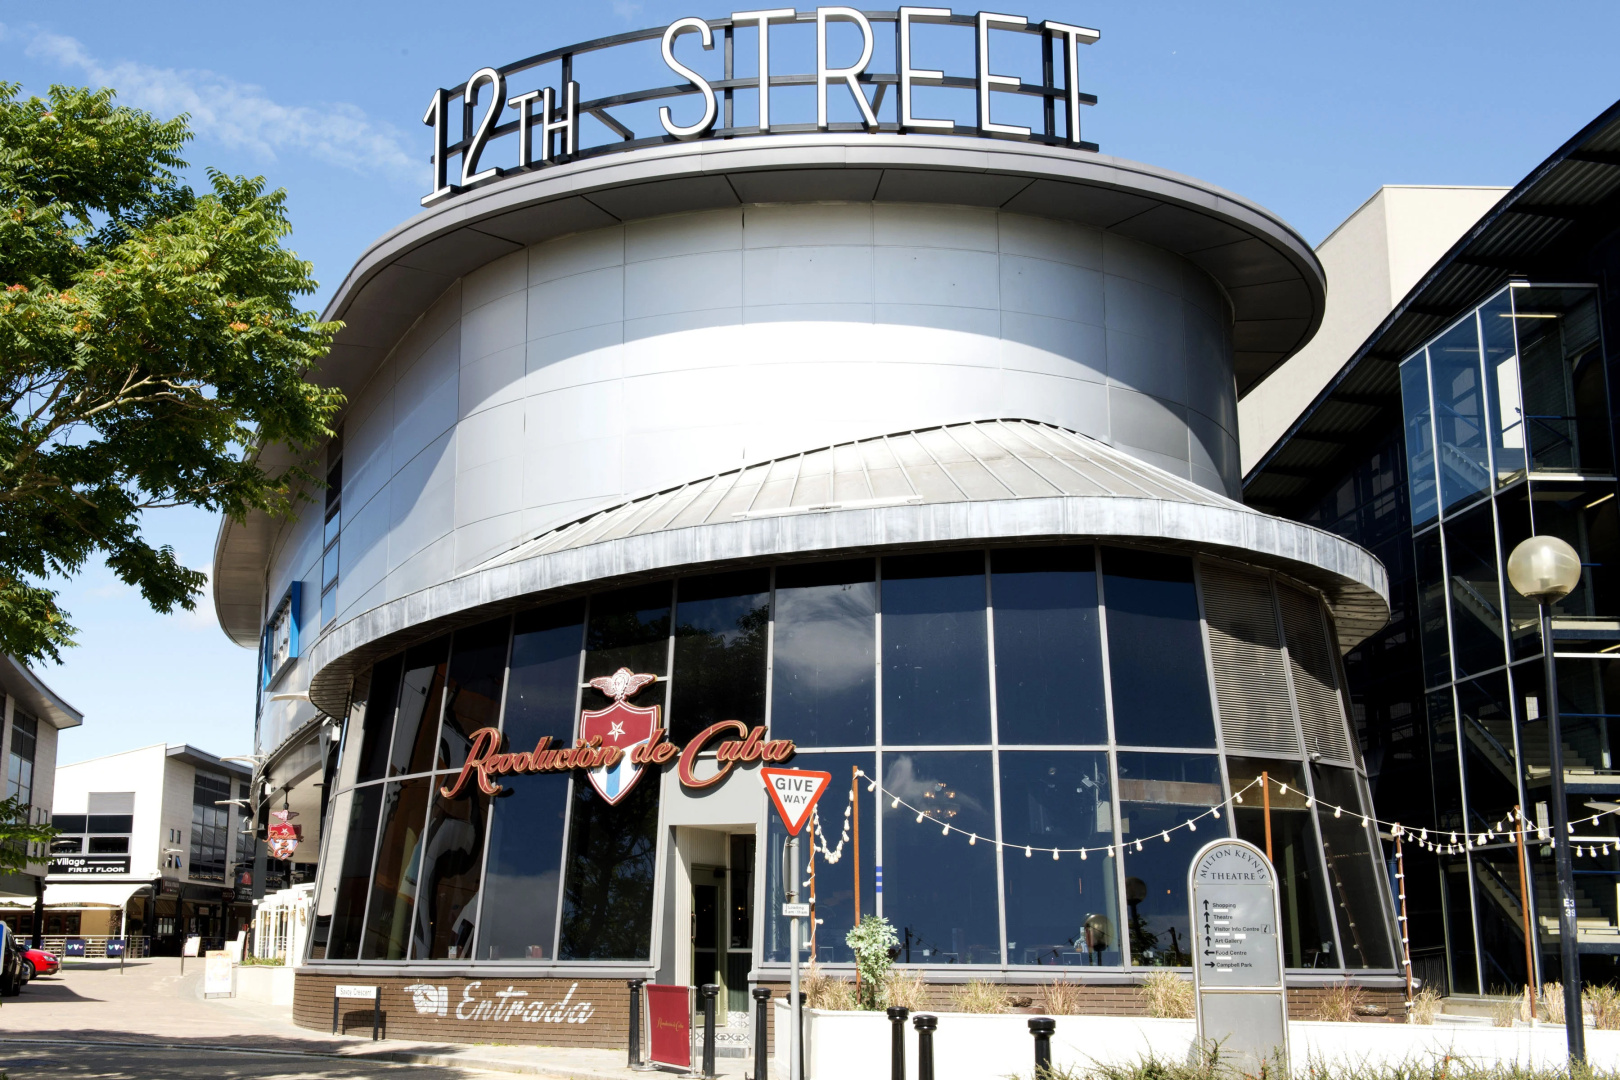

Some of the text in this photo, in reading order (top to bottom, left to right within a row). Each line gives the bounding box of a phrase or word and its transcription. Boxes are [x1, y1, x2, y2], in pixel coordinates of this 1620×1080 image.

[421, 6, 1101, 208] 12TH STREET
[440, 719, 797, 800] Revolución de Cuba
[774, 777, 814, 793] GIVE
[783, 794, 807, 804] WAY
[56, 857, 86, 867] Village
[1200, 848, 1267, 880] MILTON KEYNES
[1210, 872, 1256, 880] THEATRE
[1563, 898, 1575, 908] E3
[456, 981, 596, 1024] Entrada
